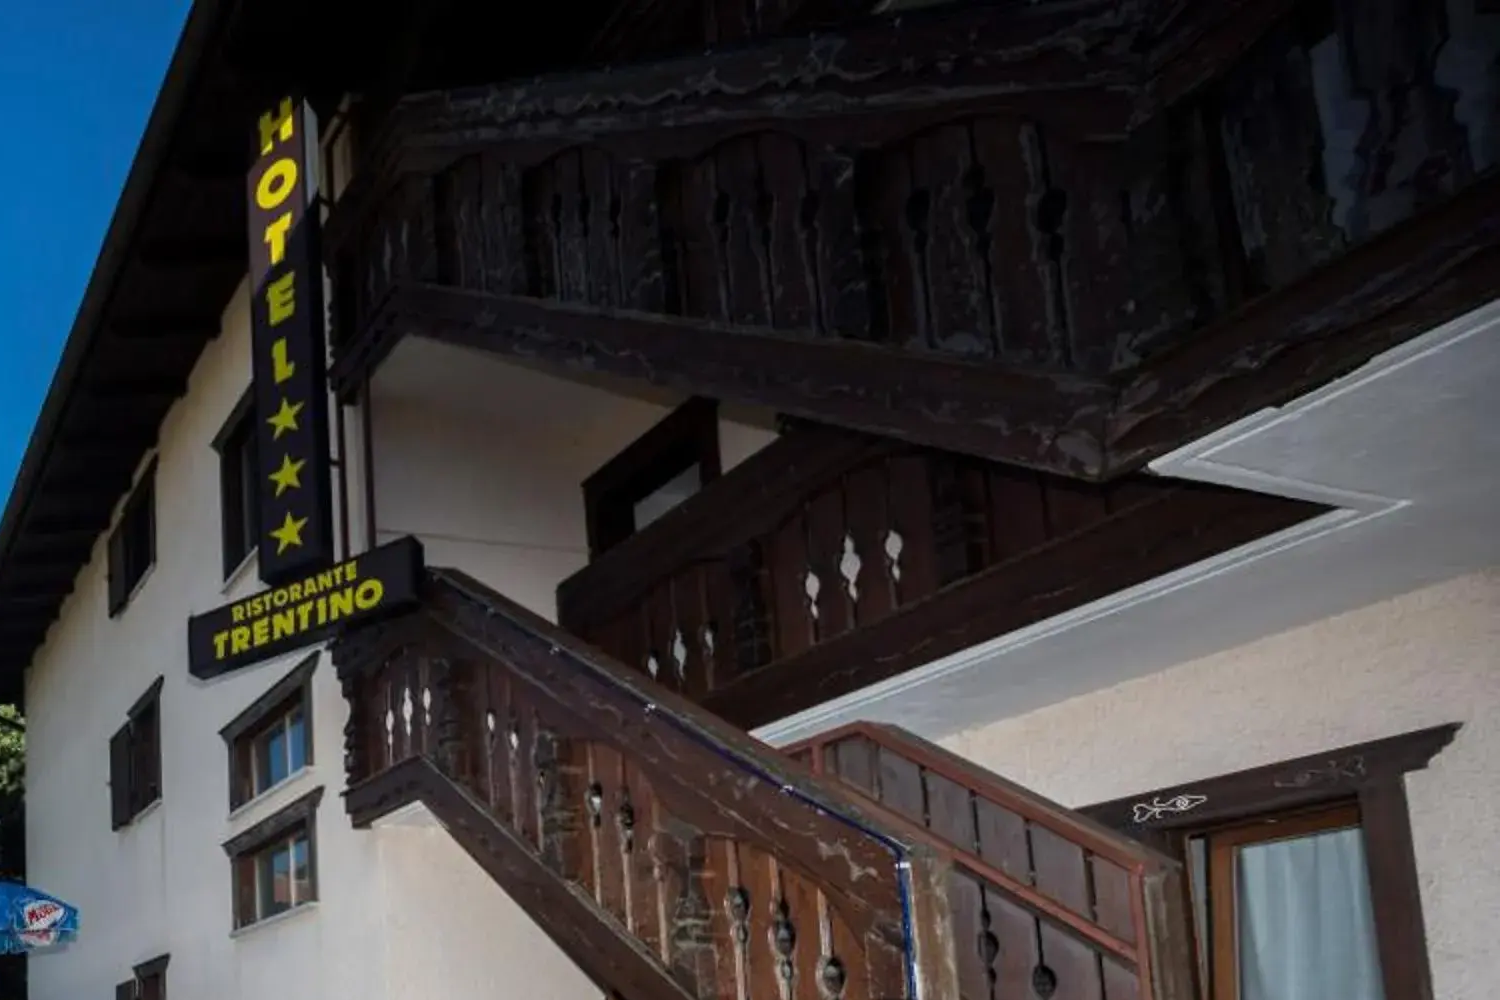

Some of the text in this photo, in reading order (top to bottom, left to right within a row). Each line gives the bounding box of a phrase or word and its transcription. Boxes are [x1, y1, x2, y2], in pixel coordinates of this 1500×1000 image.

[256, 96, 298, 384] HOTEL
[213, 579, 384, 660] TRENTINO
[232, 560, 358, 622] RISTORANTE
